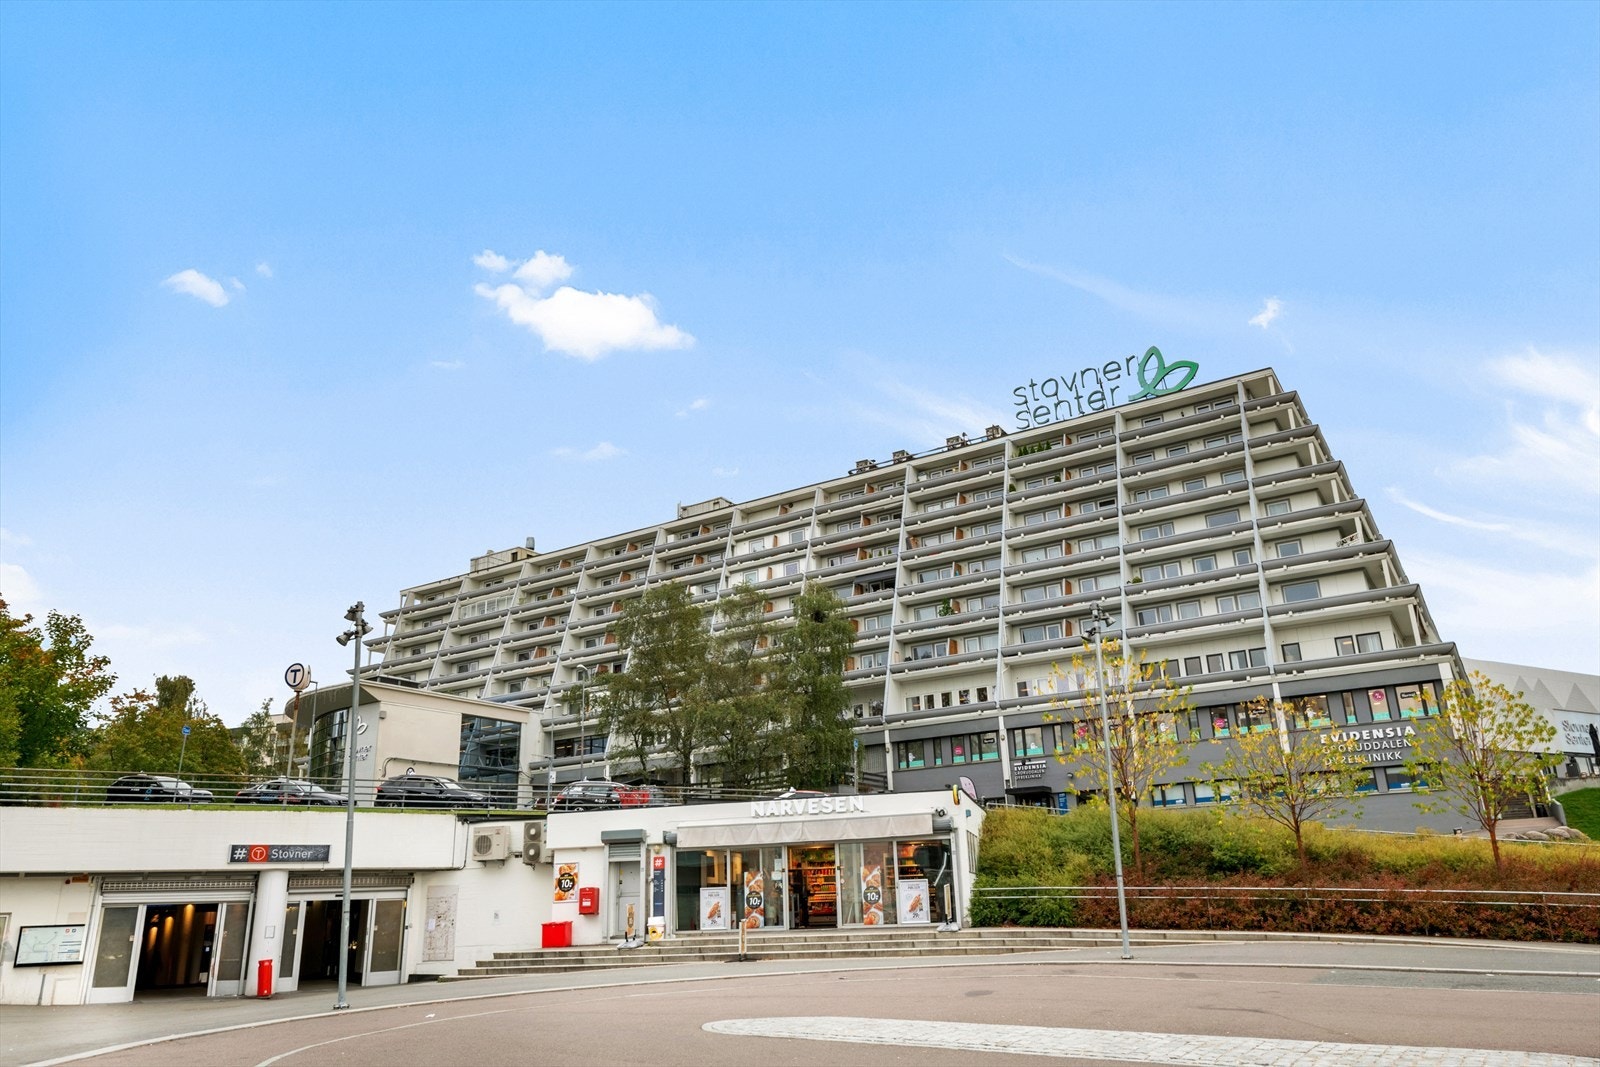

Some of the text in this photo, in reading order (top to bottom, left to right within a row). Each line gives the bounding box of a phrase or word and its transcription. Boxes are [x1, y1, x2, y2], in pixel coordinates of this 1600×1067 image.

[1013, 355, 1136, 406] stovner
[1015, 384, 1120, 430] senter
[1320, 726, 1416, 744] EVIDENSIA
[1561, 719, 1599, 734] Stovne
[751, 796, 864, 817] NARVESEN
[271, 848, 313, 859] Stovner
